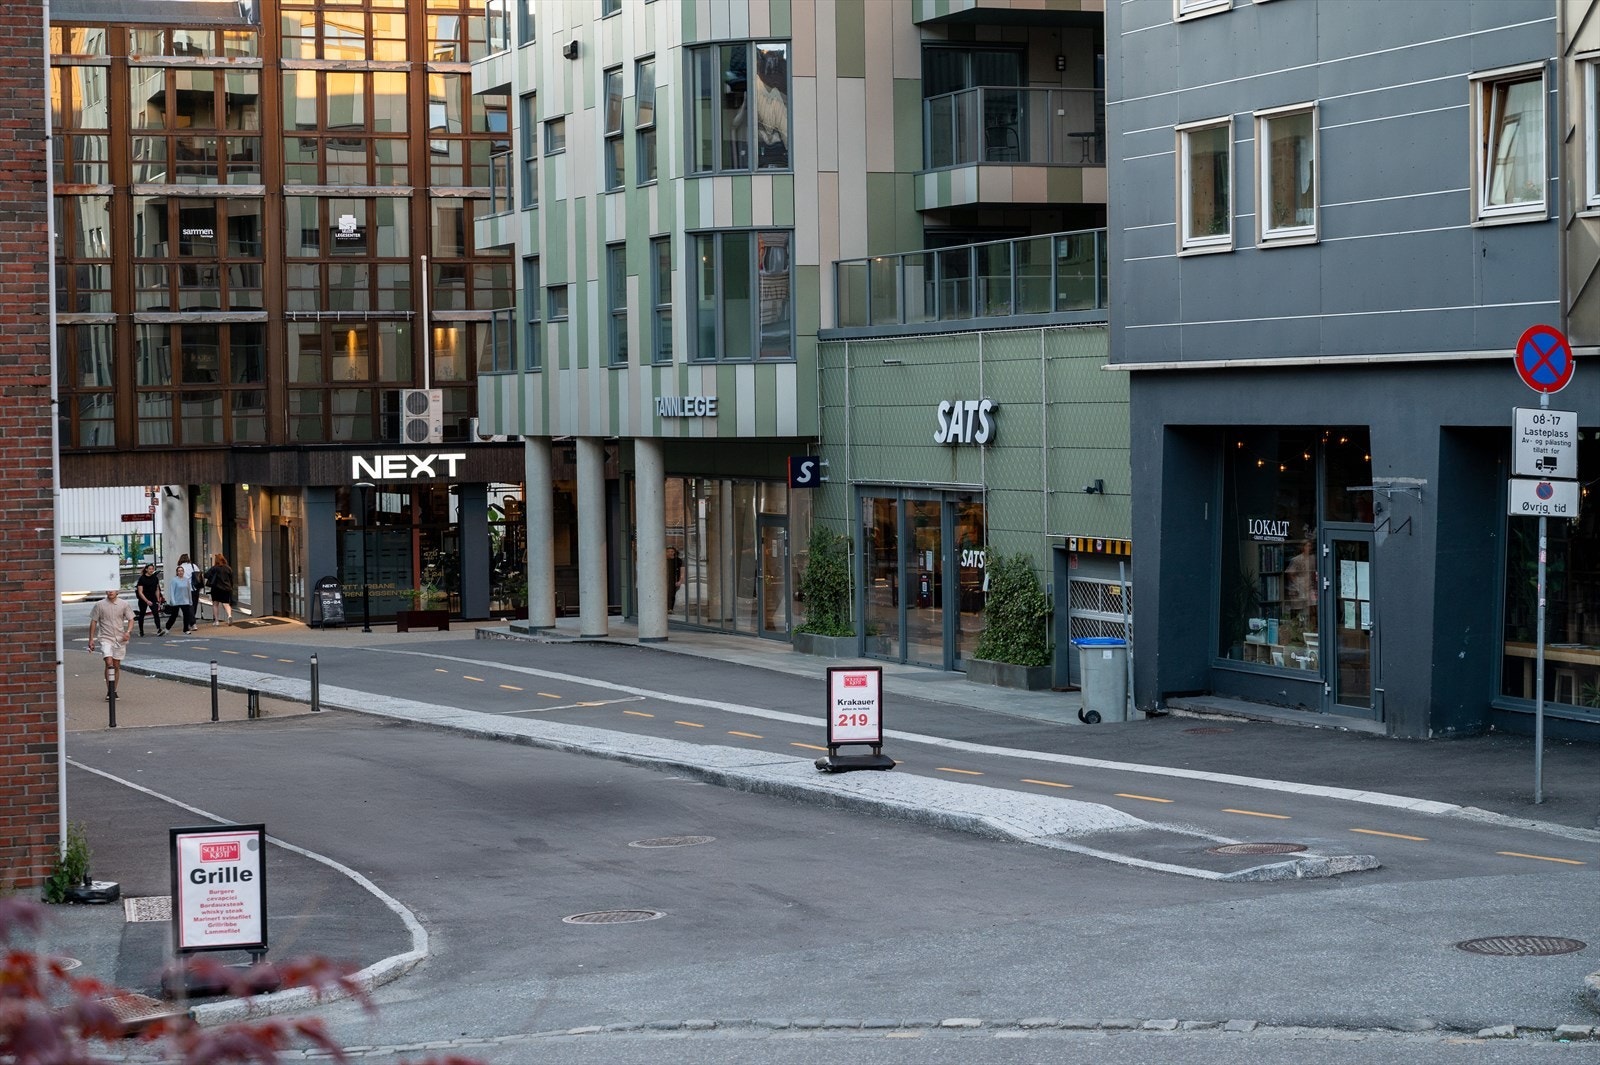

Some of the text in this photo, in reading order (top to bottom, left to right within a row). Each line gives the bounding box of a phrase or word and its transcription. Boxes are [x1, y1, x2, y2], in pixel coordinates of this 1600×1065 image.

[654, 396, 718, 417] TANNLEGE
[934, 399, 996, 445] SATS
[1532, 414, 1561, 426] 08-17
[1524, 427, 1569, 438] Lasteplass
[352, 453, 466, 480] NEXT
[796, 461, 815, 483] S
[1522, 501, 1567, 514] Øvrig tid
[1248, 518, 1290, 537] LOKALT
[961, 549, 985, 568] SATS
[837, 698, 875, 706] Krakauer
[838, 713, 868, 726] 219
[202, 845, 237, 853] SOLHEIM
[190, 866, 253, 885] Grille
